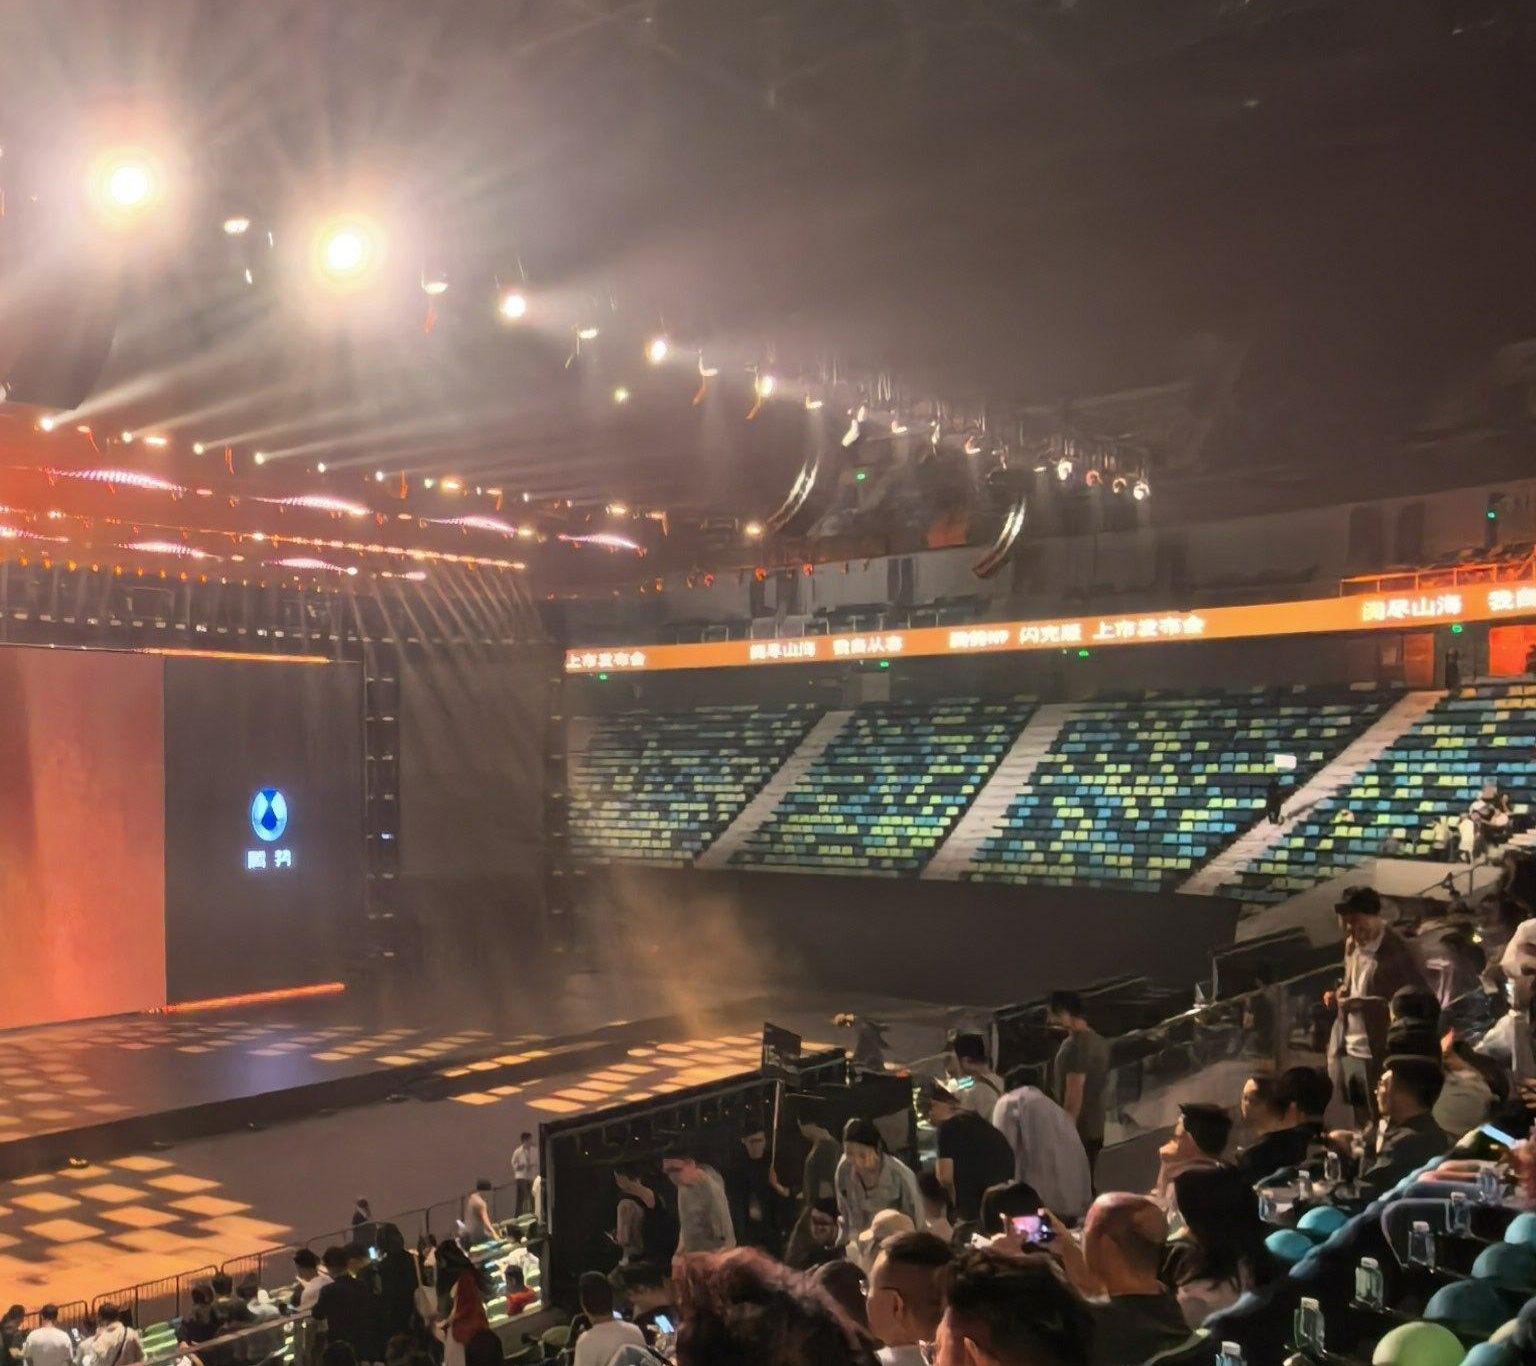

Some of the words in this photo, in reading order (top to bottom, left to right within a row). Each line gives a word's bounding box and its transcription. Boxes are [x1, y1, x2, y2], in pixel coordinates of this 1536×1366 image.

[1092, 615, 1205, 640] 上市发布会
